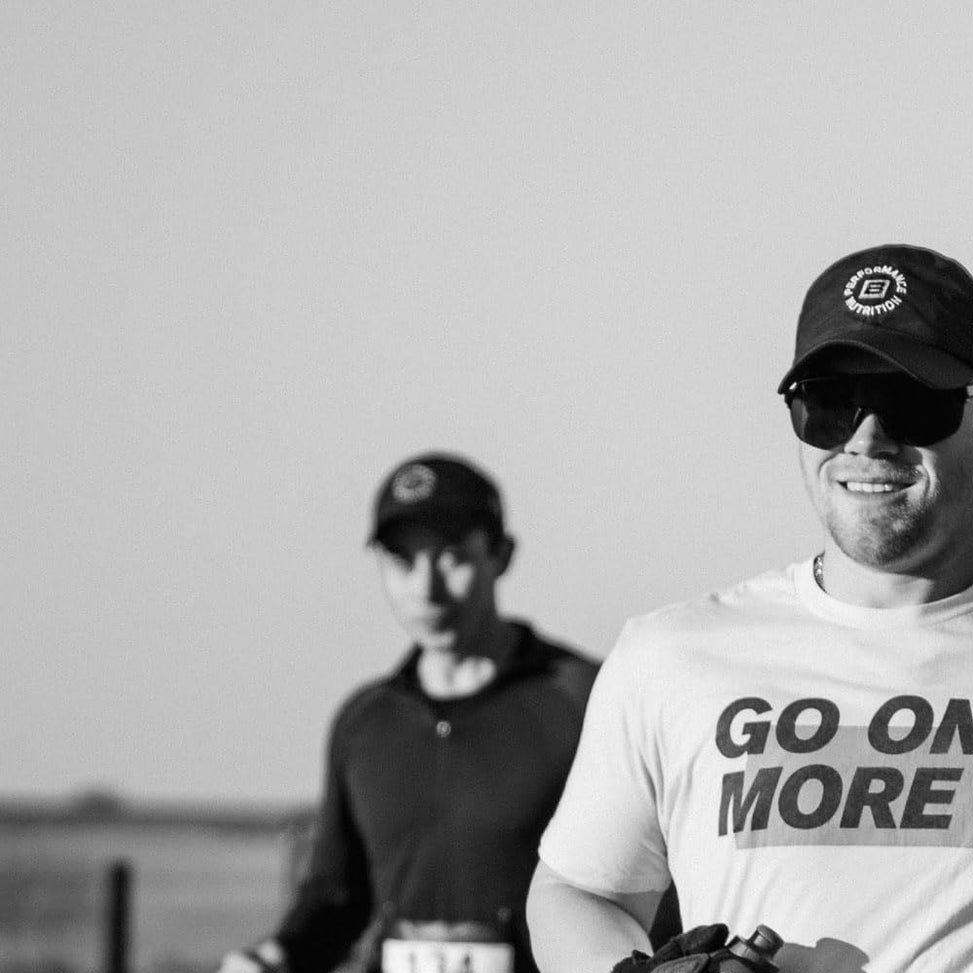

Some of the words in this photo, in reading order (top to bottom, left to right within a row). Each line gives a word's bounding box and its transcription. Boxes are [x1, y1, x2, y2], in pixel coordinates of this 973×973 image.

[843, 265, 908, 297] PERFORMANCE
[845, 295, 903, 316] NUTRITION
[715, 696, 841, 759] GO
[717, 763, 965, 837] MORE
